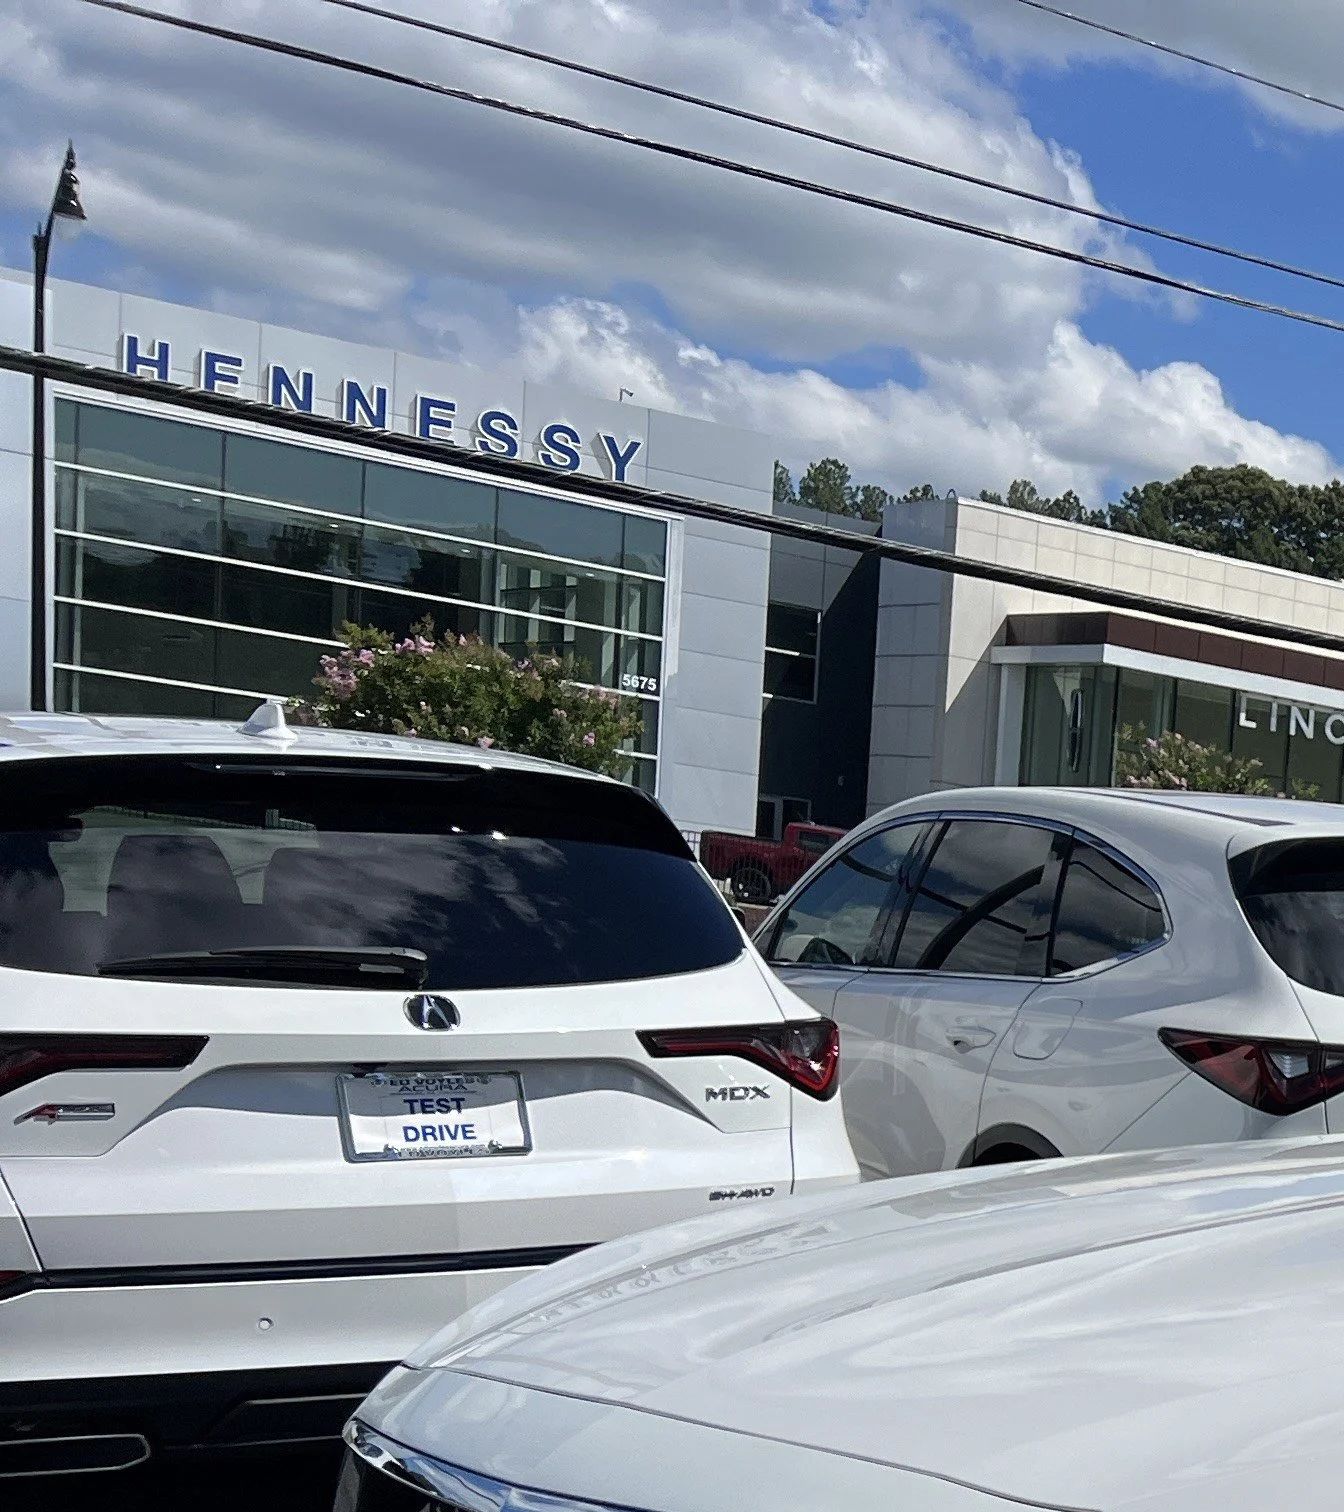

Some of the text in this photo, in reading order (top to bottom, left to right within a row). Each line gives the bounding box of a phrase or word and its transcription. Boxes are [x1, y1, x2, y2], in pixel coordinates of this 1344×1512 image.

[121, 332, 643, 482] HENNESSY
[622, 673, 657, 692] 5675
[705, 1085, 771, 1102] MDX
[403, 1097, 466, 1115] TEST
[402, 1123, 477, 1143] DRIVE
